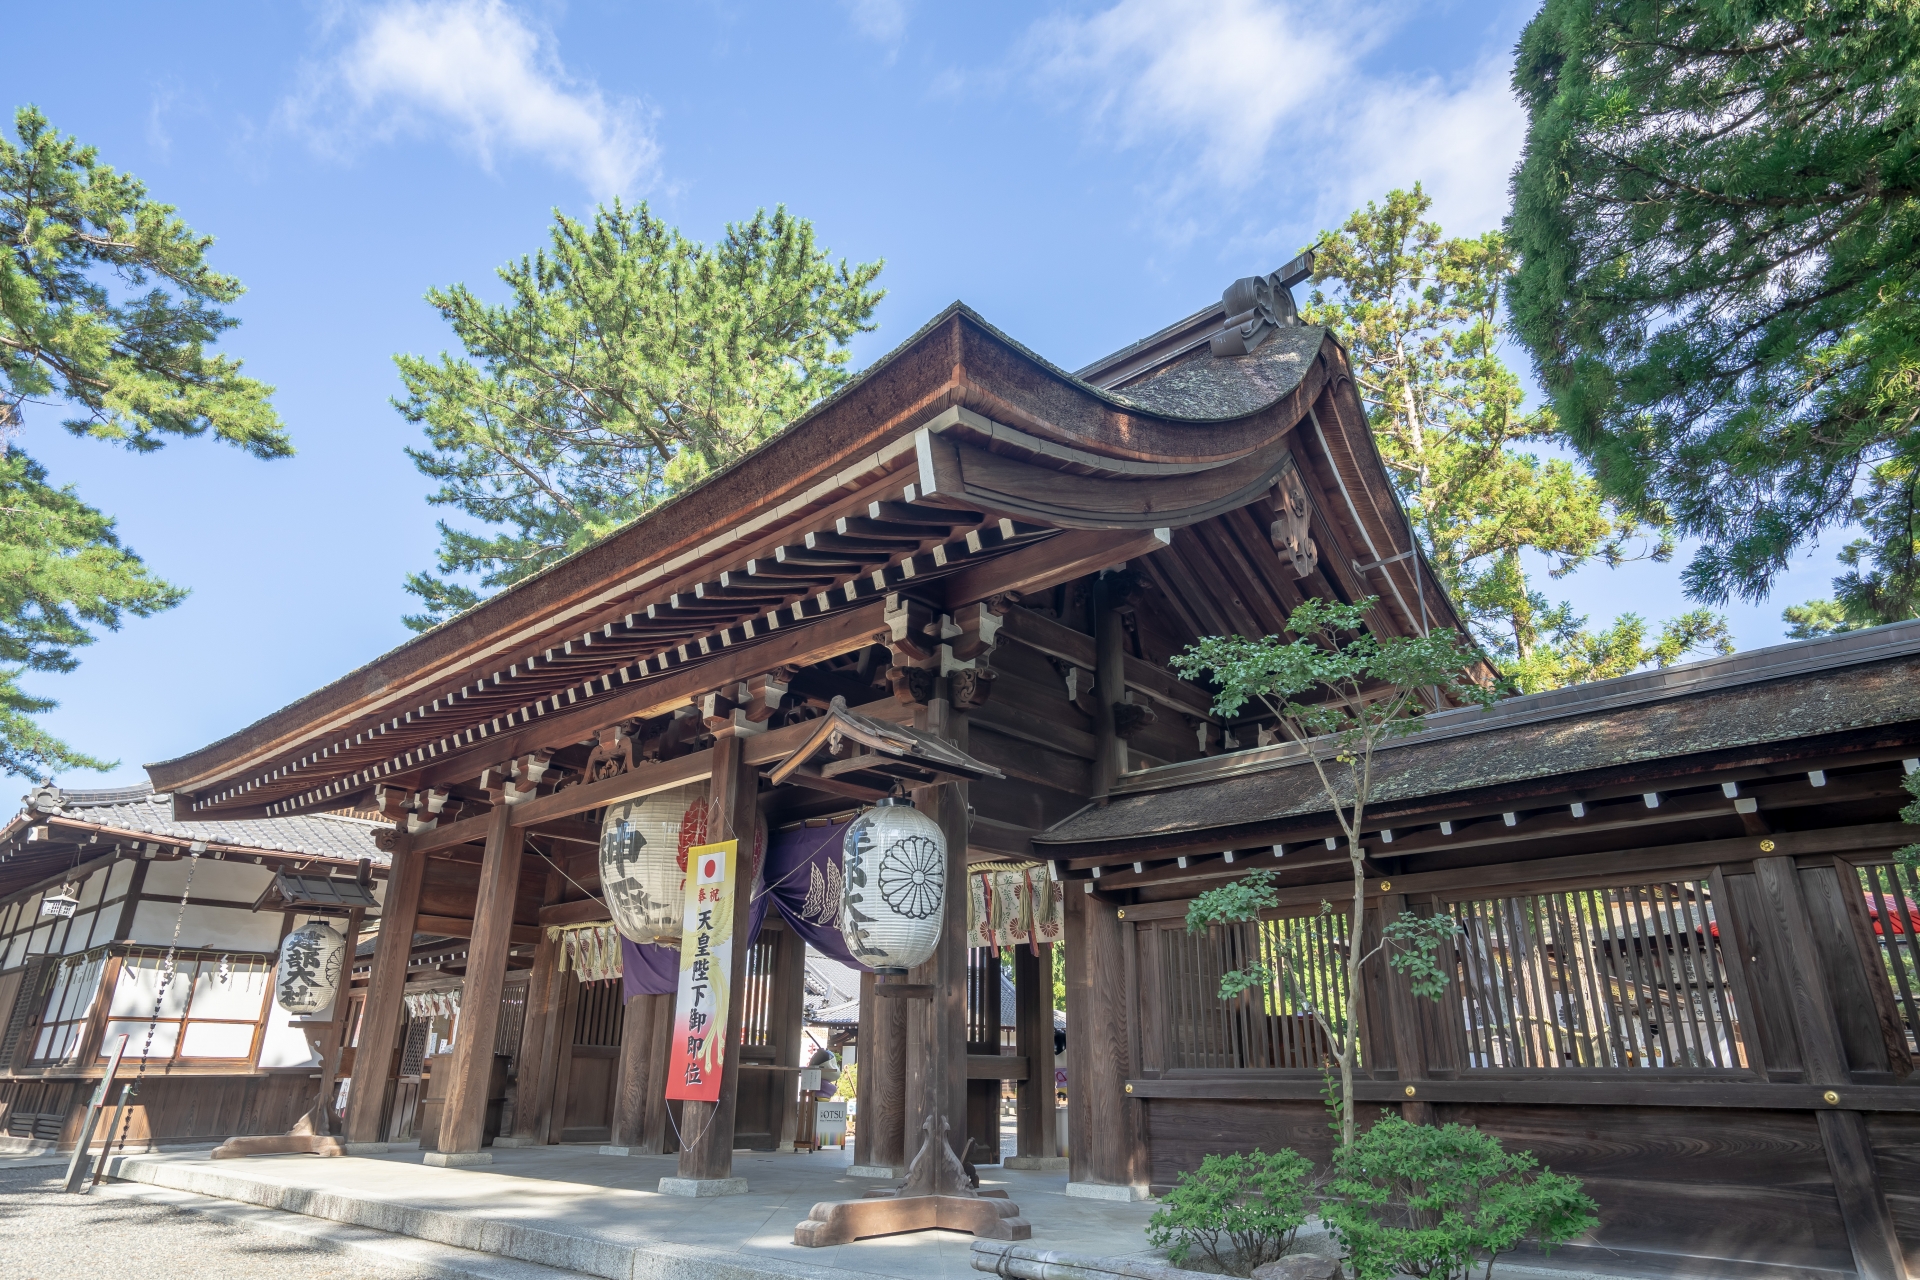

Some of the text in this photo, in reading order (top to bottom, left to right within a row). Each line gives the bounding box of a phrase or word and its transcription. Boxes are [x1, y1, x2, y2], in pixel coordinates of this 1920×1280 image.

[697, 887, 720, 905] 奉祝
[280, 930, 326, 1007] 建部大社
[684, 909, 714, 1087] 天皇陛下御即位
[823, 1110, 844, 1119] OTSU
